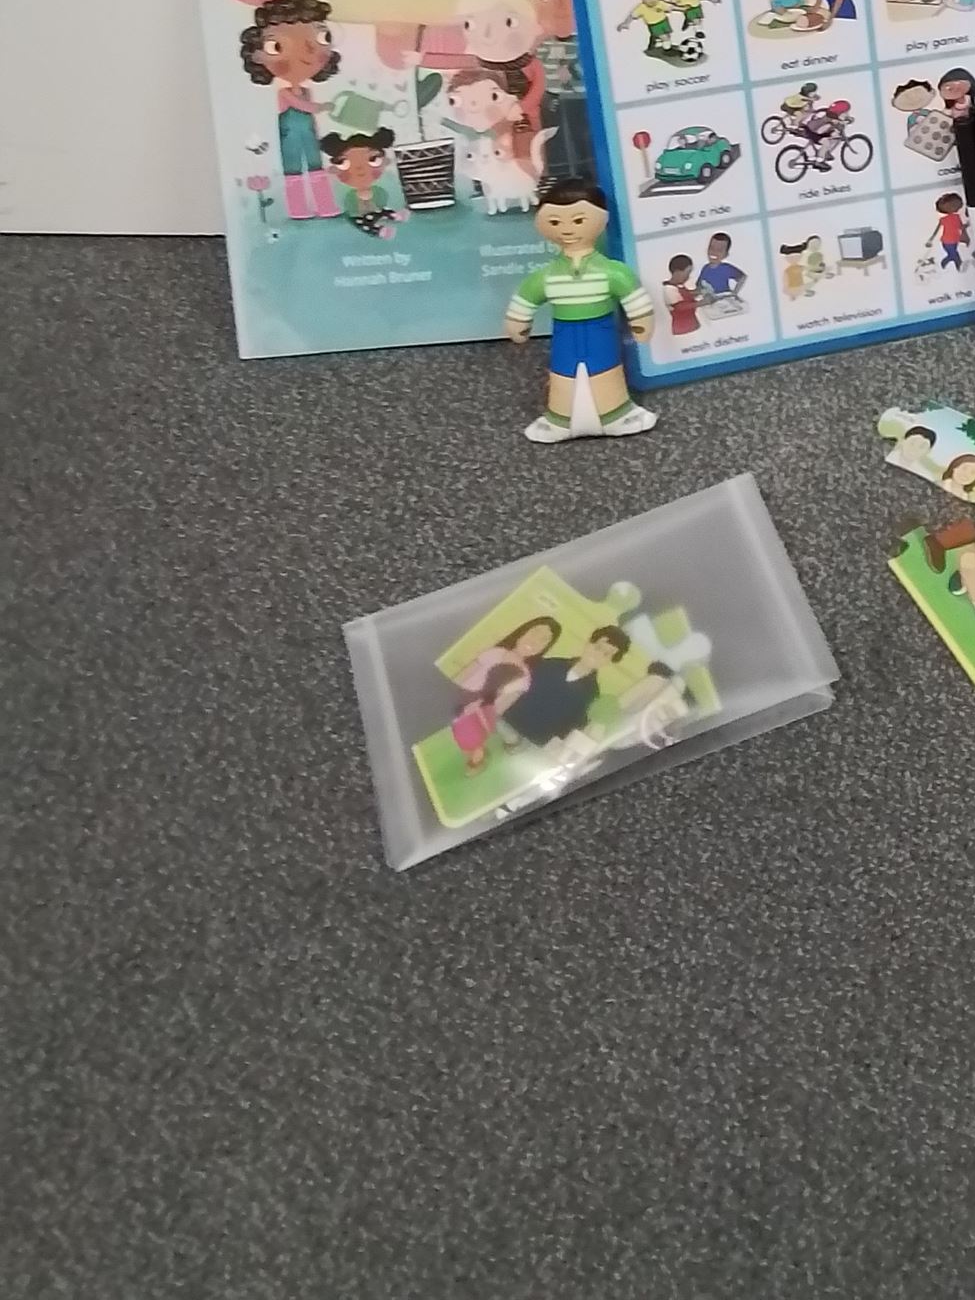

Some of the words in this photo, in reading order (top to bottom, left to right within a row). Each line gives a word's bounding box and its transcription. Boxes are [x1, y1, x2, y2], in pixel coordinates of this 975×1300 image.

[906, 40, 929, 53] play
[933, 34, 970, 50] games
[781, 58, 800, 71] eat
[803, 53, 839, 68] dinner
[646, 79, 671, 93] play
[674, 73, 711, 88] soccer
[799, 188, 821, 199] ride
[822, 184, 852, 196] bikes
[662, 215, 676, 228] go
[680, 211, 696, 221] for
[709, 204, 731, 215] ride
[393, 252, 411, 267] by
[928, 292, 952, 305] walk
[955, 289, 973, 299] the
[797, 317, 829, 331] watch
[833, 307, 884, 323] television
[681, 341, 711, 355] wash
[714, 333, 749, 348] dishes
